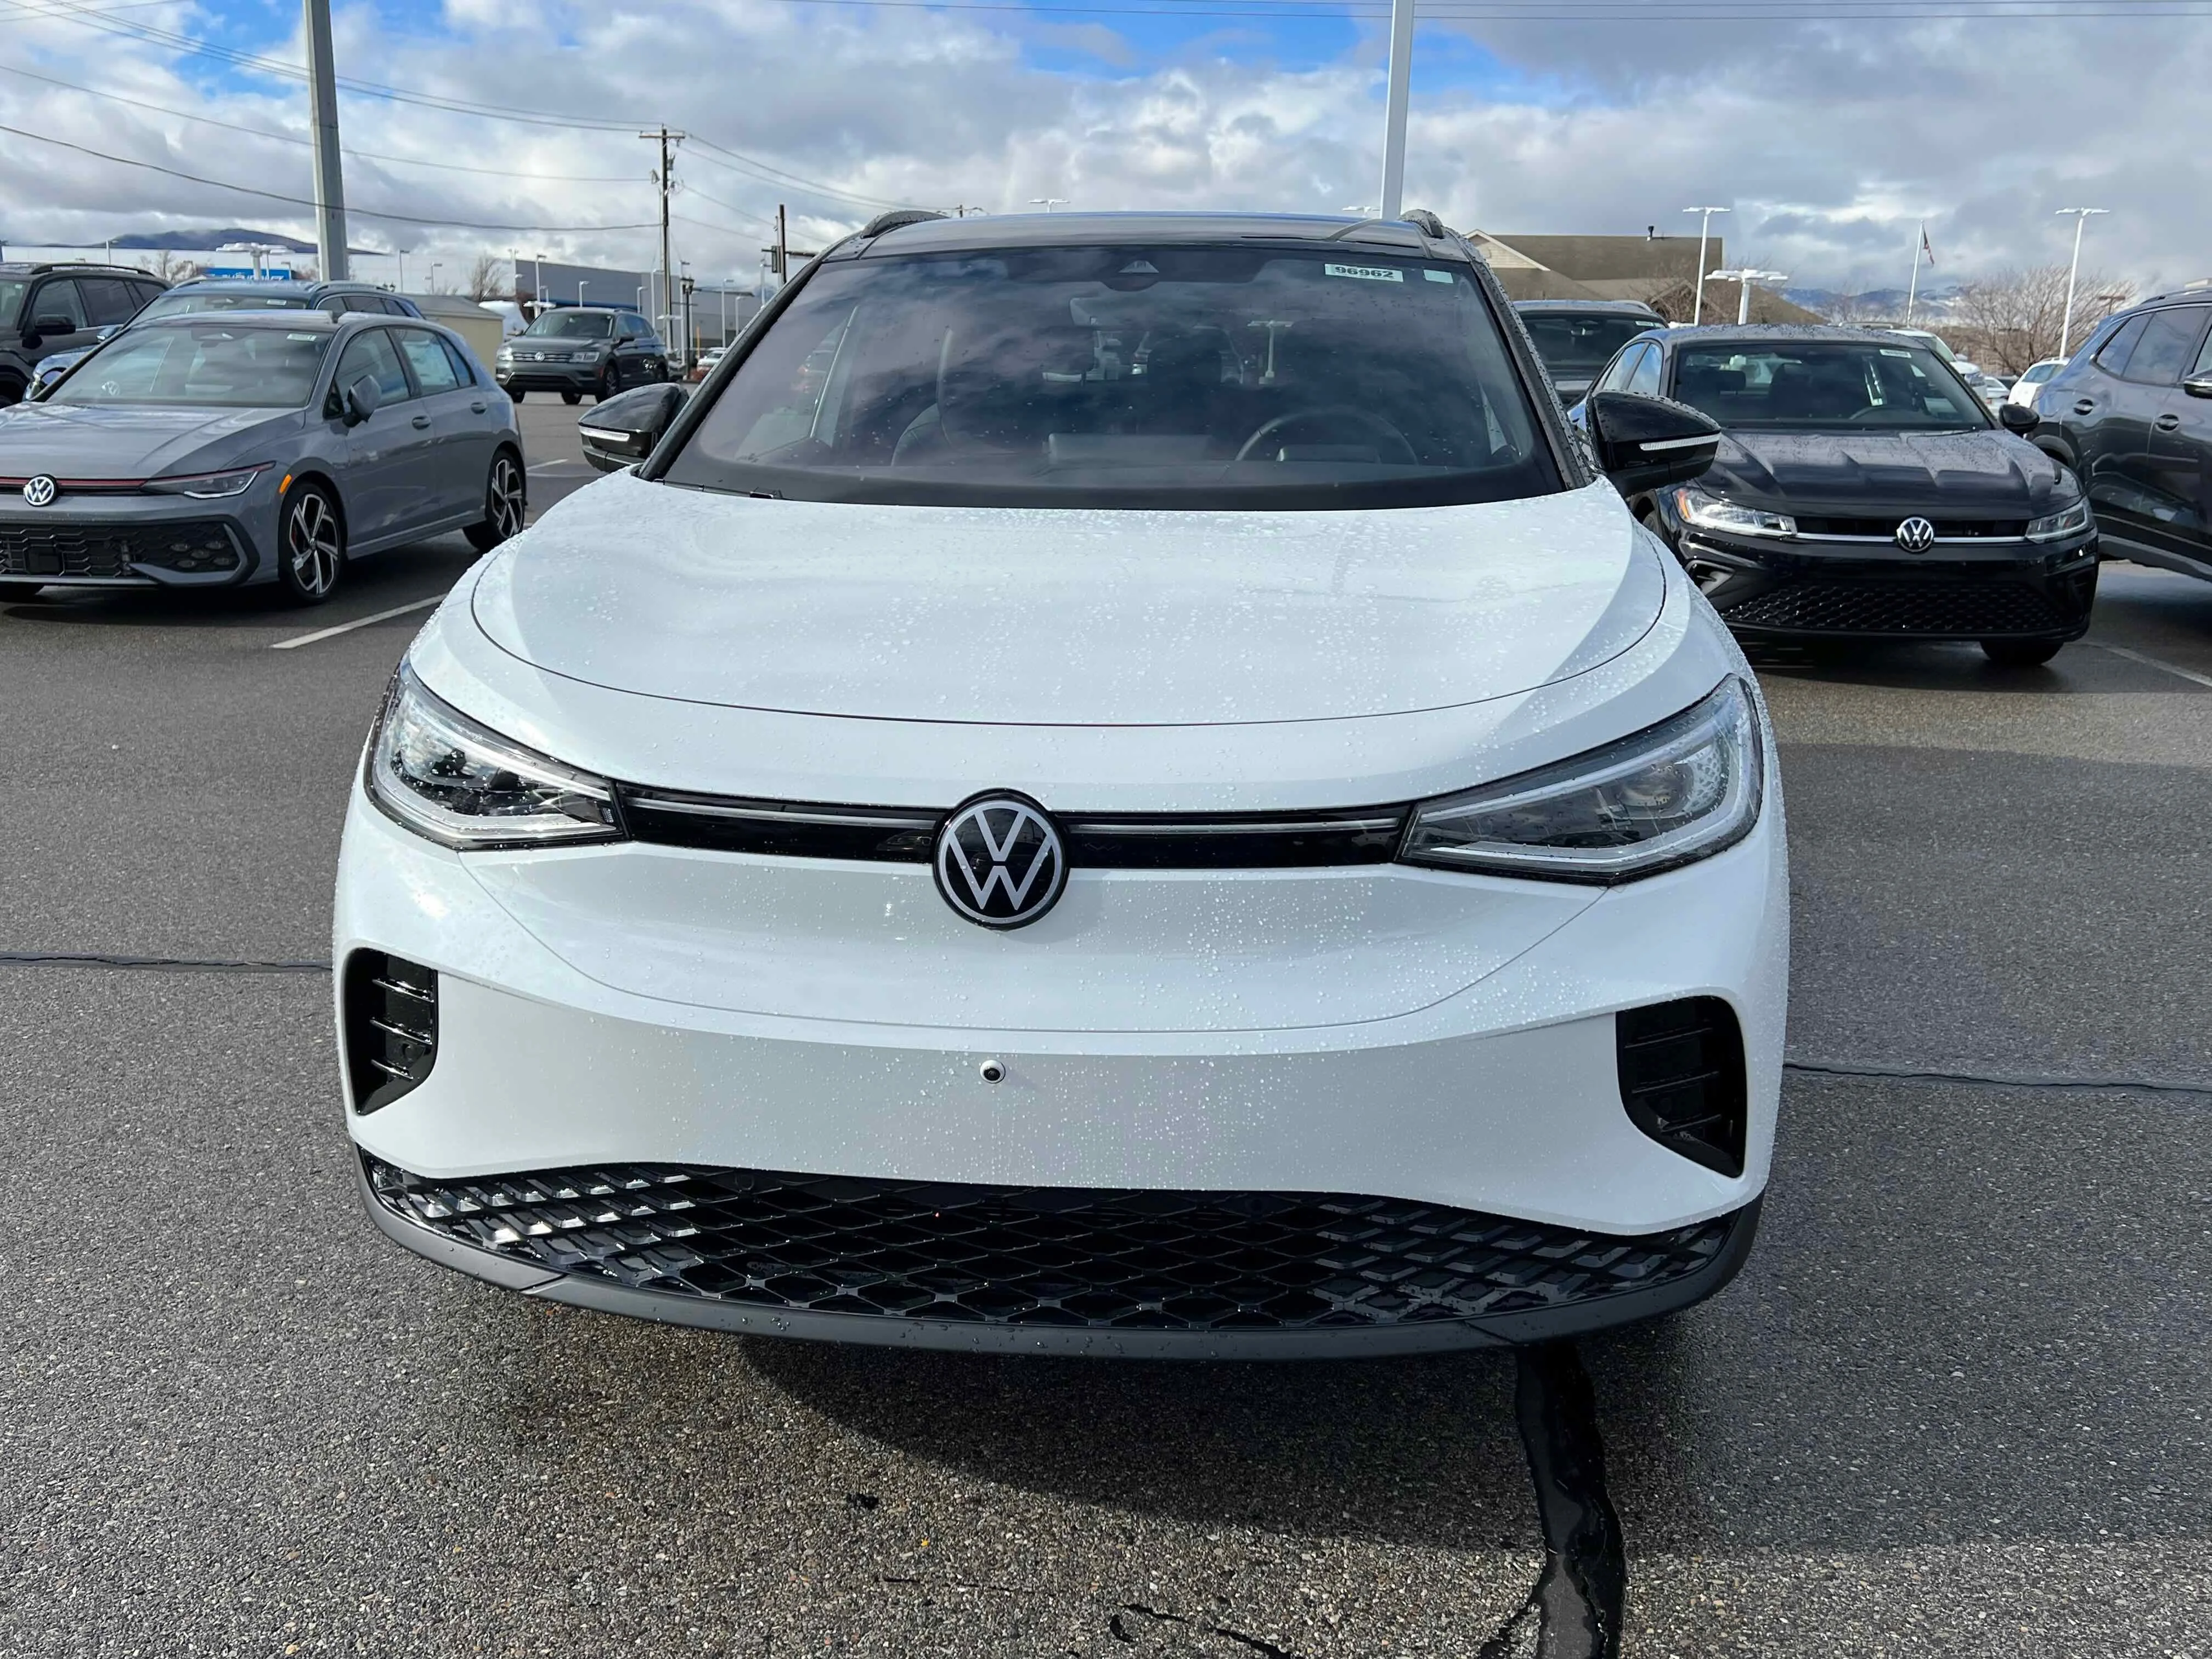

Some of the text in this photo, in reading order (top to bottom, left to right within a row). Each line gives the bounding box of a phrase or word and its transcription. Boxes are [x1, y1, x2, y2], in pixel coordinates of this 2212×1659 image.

[1334, 266, 1394, 278] 96962
[24, 476, 54, 506] VW
[1897, 517, 1934, 552] VW
[938, 800, 1063, 924] VW
